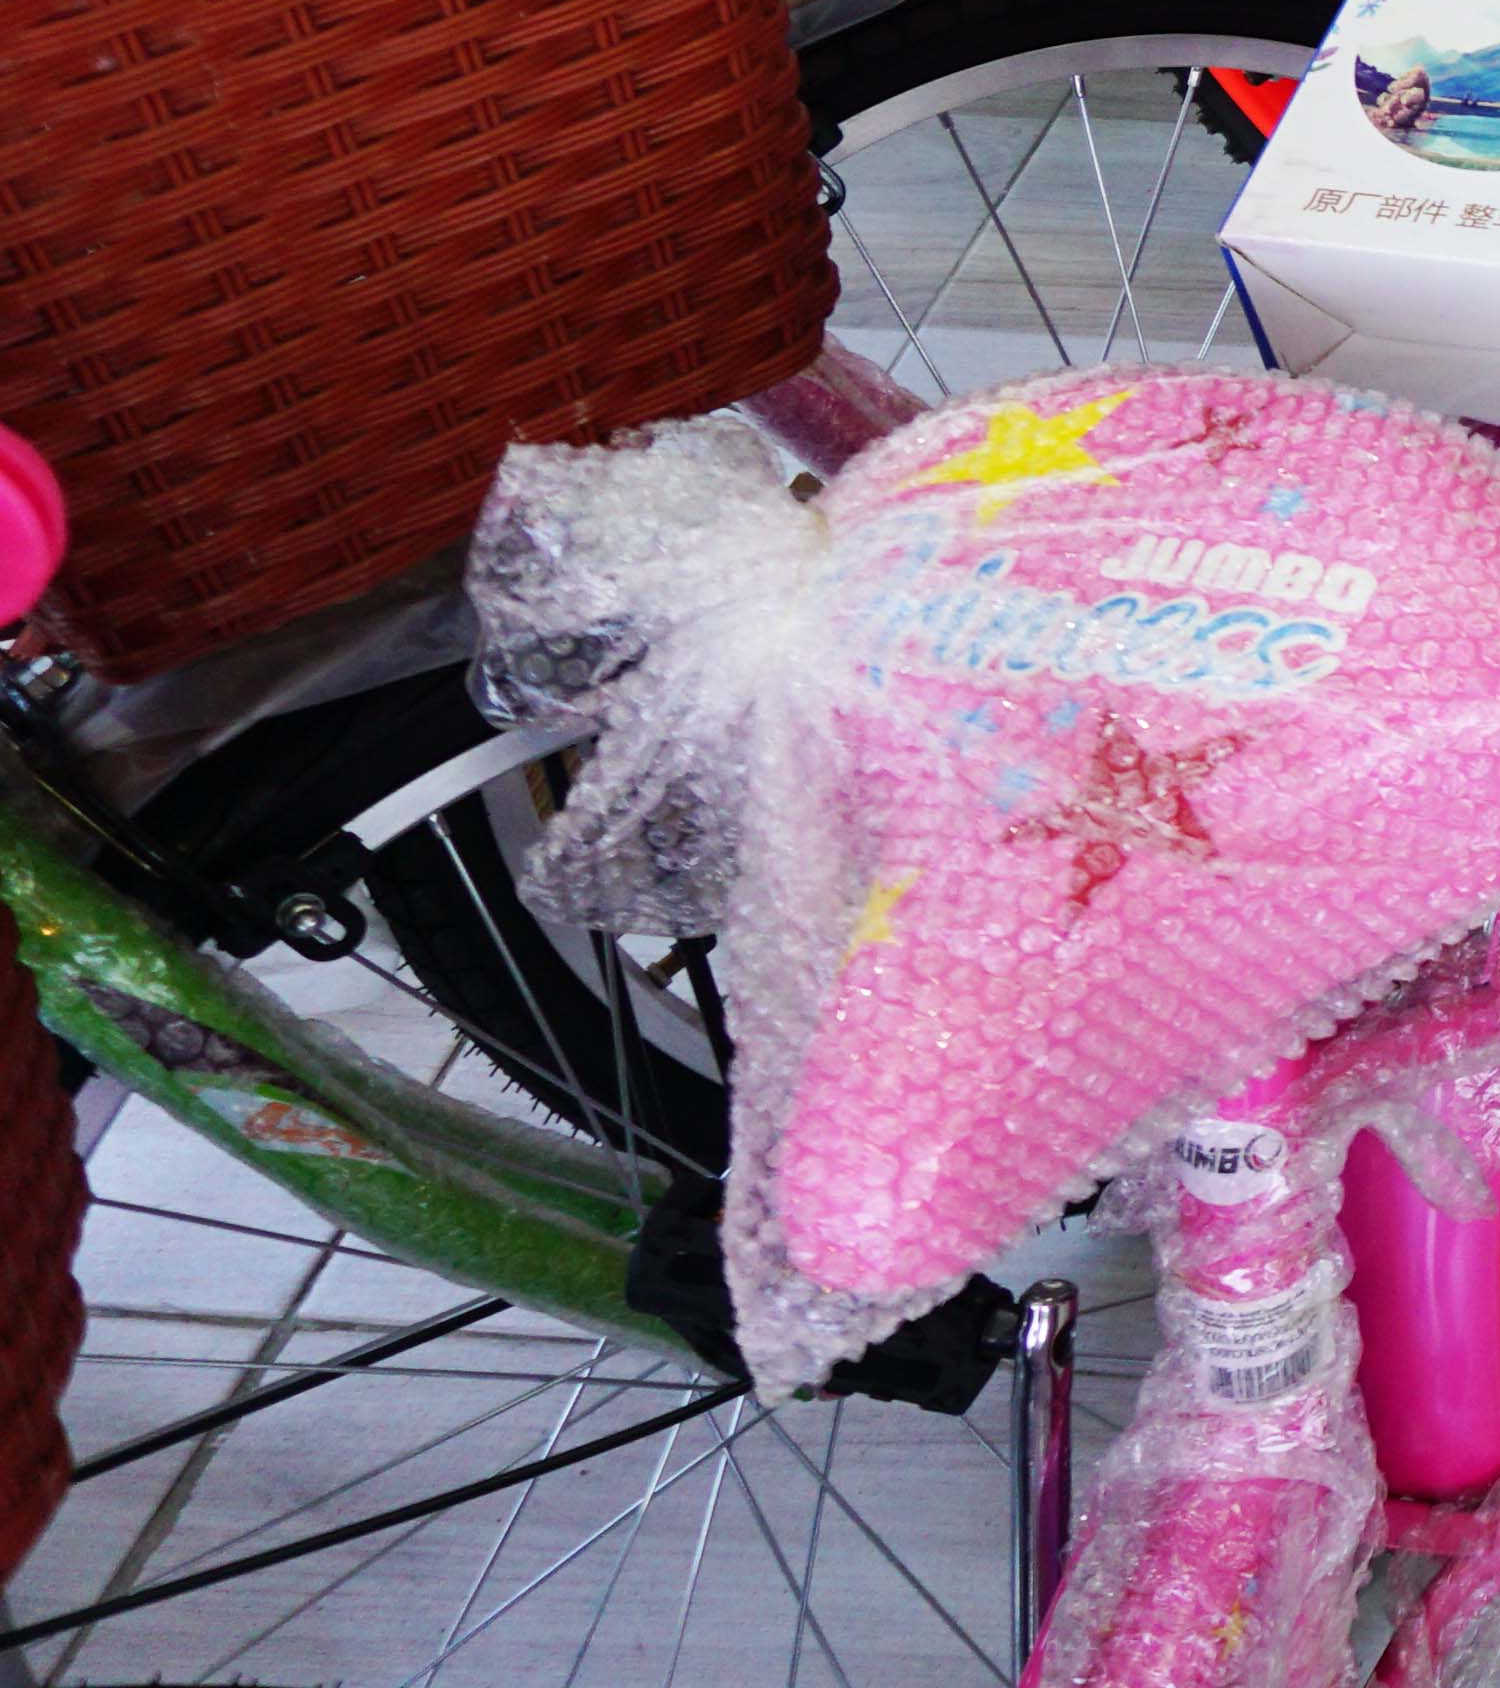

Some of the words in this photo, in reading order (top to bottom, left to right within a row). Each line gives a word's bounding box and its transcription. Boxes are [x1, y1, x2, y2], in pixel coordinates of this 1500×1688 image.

[1302, 187, 1450, 225] 原厂部件
[1101, 534, 1377, 612] JUMBO
